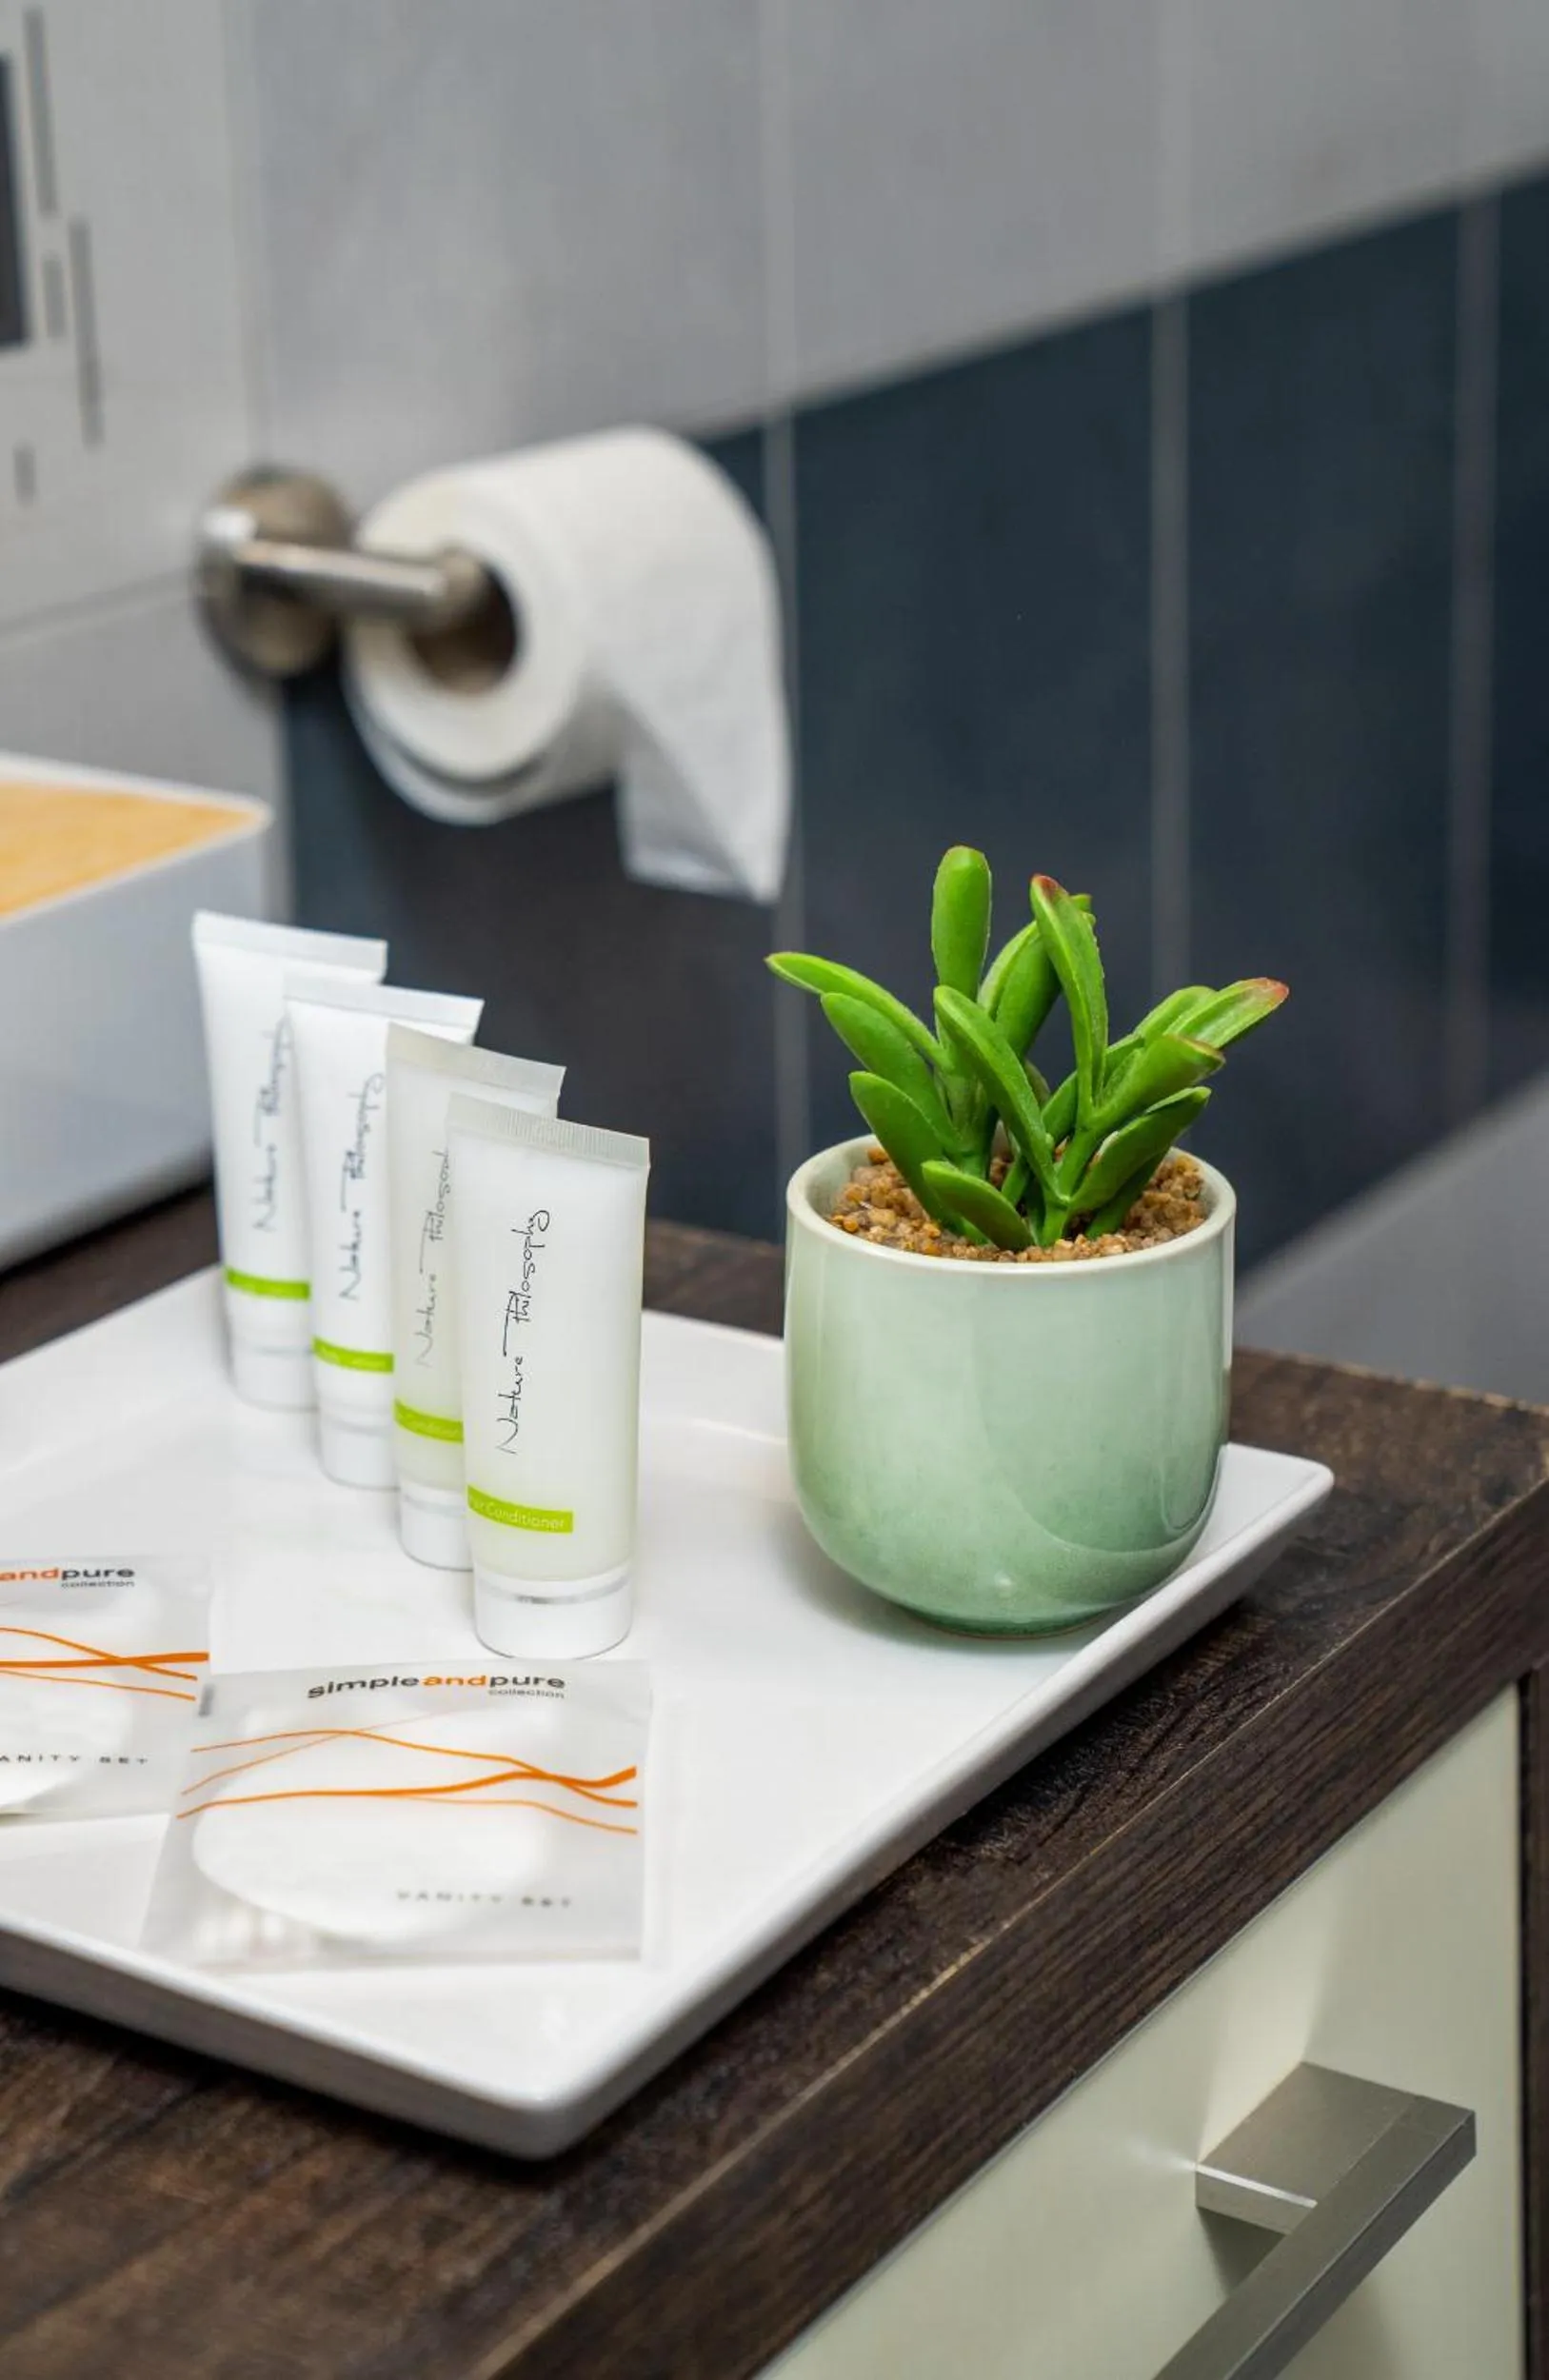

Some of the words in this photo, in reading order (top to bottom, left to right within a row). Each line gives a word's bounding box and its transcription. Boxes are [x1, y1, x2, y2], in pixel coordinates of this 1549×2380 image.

[340, 1072, 385, 1213] Philosophy
[338, 1210, 363, 1301] Nature
[503, 1209, 550, 1357] Philosophy
[413, 1274, 437, 1368] Nature
[495, 1356, 524, 1455] Nature
[487, 1688, 566, 1699] collection
